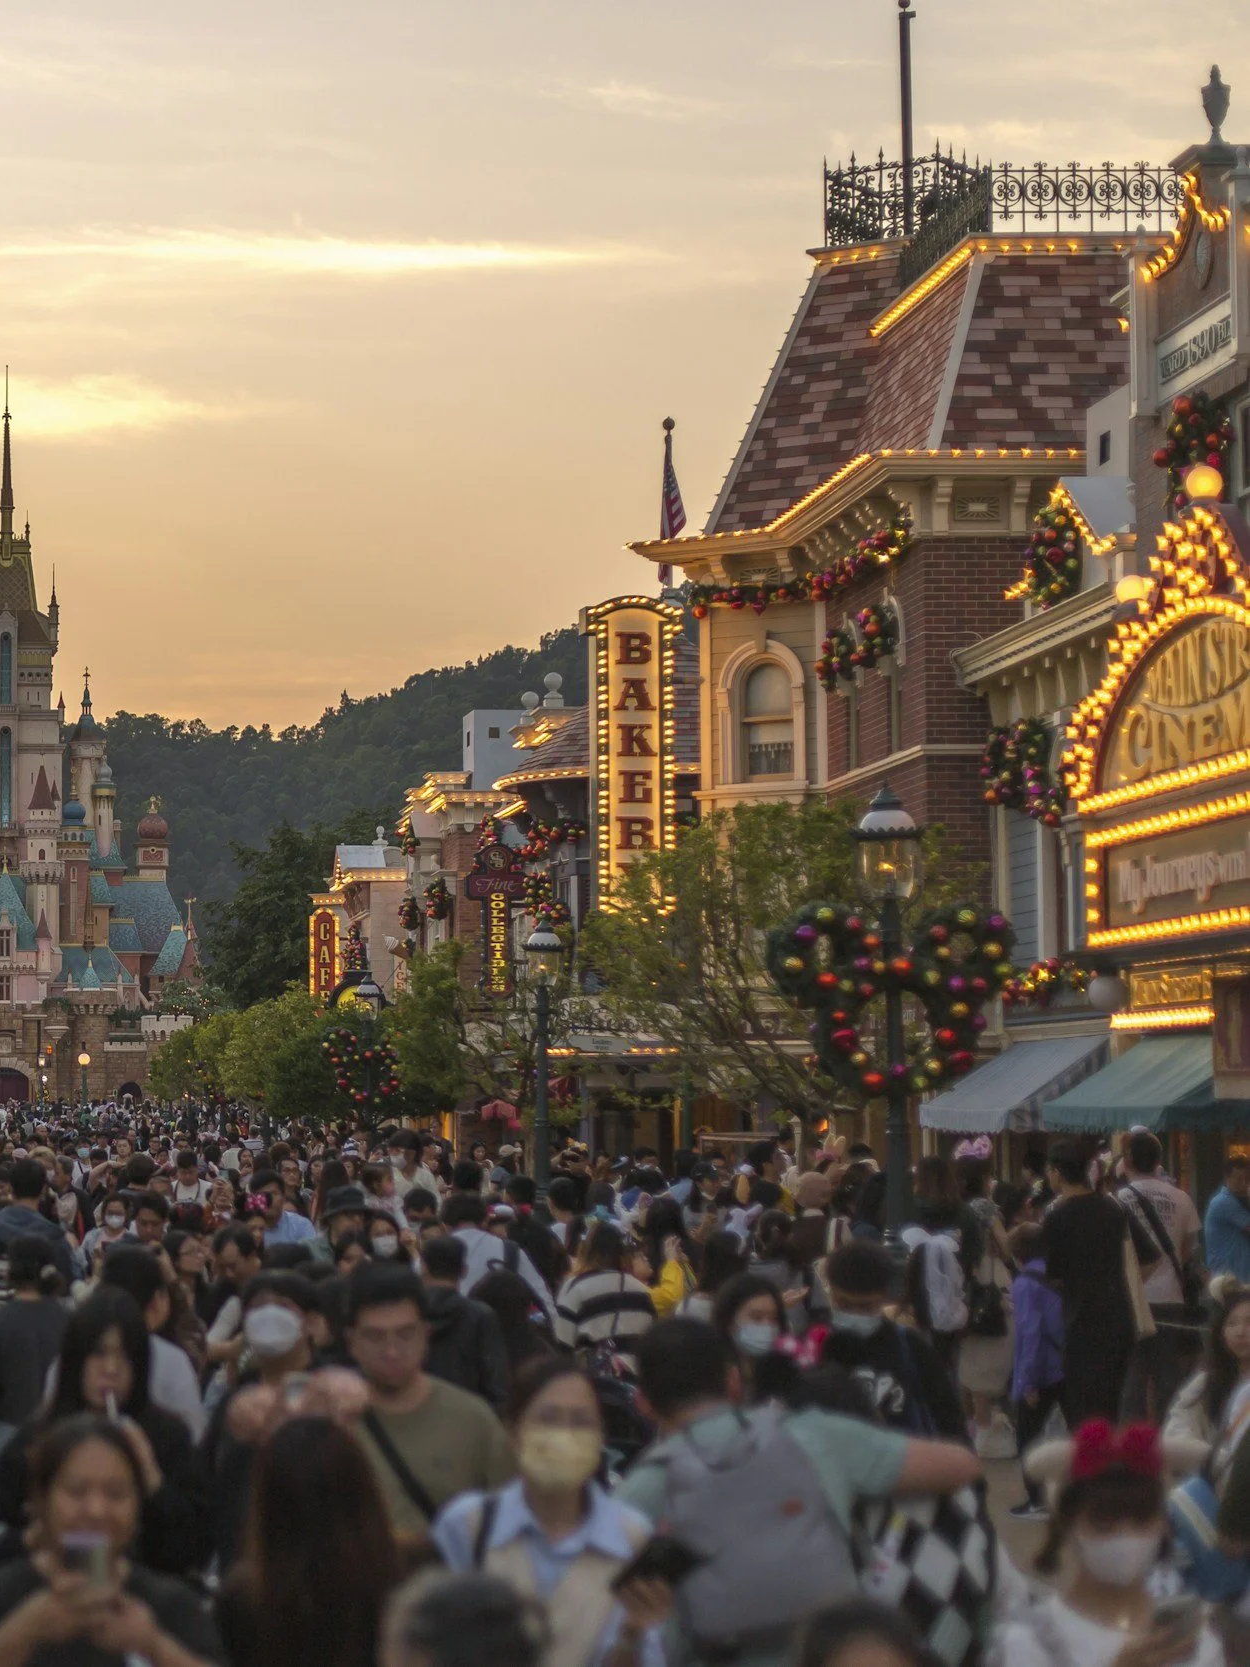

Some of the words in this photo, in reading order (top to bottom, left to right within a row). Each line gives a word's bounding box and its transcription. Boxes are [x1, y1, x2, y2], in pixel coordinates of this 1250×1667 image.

[1187, 324, 1216, 368] 1890
[1146, 627, 1208, 706] MAIN
[613, 631, 658, 876] BAKER
[476, 878, 520, 893] Fine
[1141, 850, 1220, 904] Journeys
